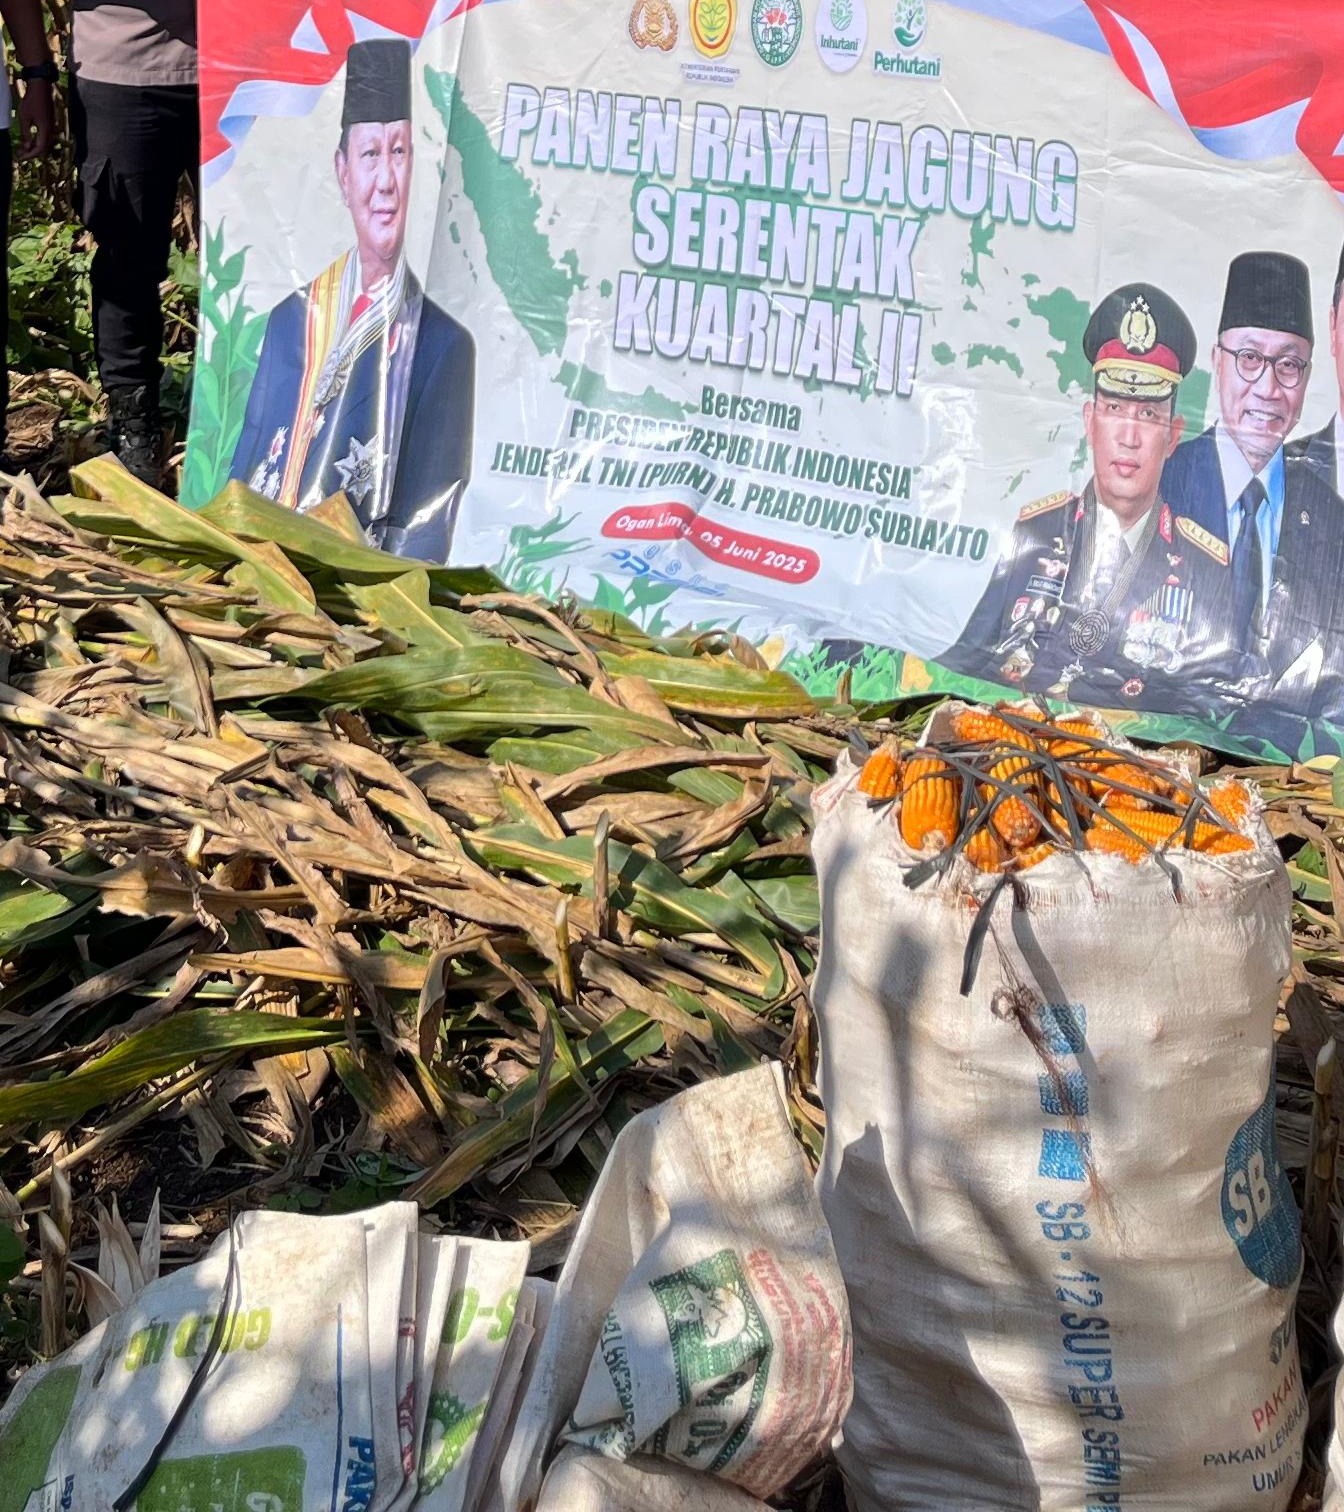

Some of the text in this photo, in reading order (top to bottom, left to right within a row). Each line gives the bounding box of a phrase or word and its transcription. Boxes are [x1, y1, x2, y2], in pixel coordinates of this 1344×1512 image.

[873, 49, 942, 77] Perhutani
[500, 82, 1079, 232] PANEN RAYA JAGUNG
[633, 185, 922, 302] SERENTAK
[613, 270, 923, 398] KUARTAL II
[701, 384, 800, 432] Bersama
[684, 426, 792, 475] REPUBLIK
[792, 446, 913, 500] INDONESIA
[598, 456, 639, 488] TNI
[713, 477, 736, 509] H.
[741, 483, 863, 536] PRABOWO
[864, 507, 990, 561] SUBIANTO
[616, 514, 655, 532] Ogan
[699, 530, 723, 549] 05
[723, 540, 761, 562] Juni
[761, 550, 808, 574] 2025
[1035, 1199, 1092, 1241] SB
[1228, 1147, 1271, 1237] SB
[1060, 1312, 1125, 1421] SUPER
[1251, 1359, 1298, 1433] PAKAN
[1081, 1428, 1122, 1487] SEMI
[1203, 1444, 1266, 1467] PAKAN
